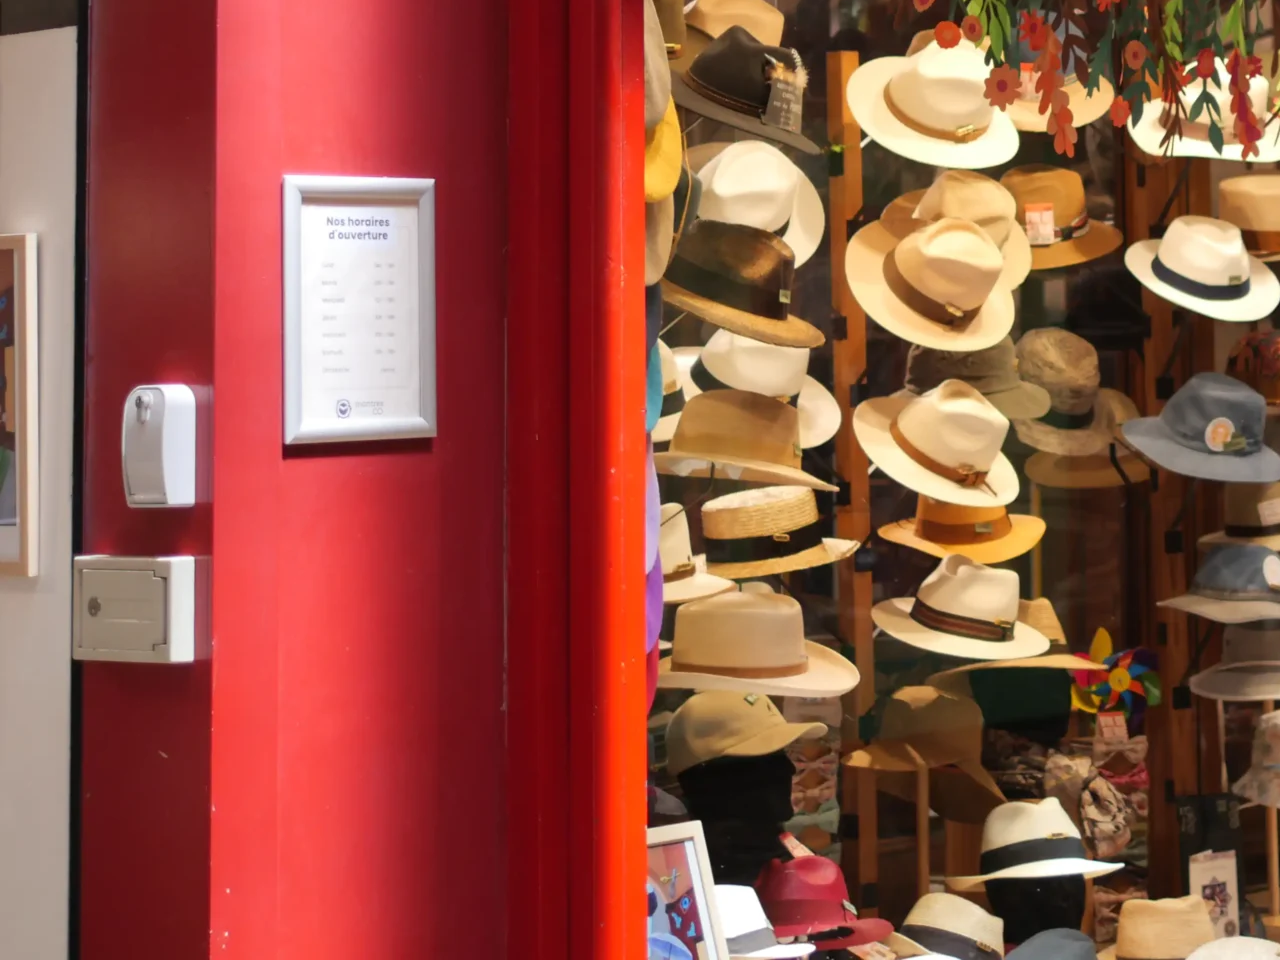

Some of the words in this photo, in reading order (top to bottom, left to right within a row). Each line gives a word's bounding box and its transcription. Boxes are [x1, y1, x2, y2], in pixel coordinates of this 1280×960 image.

[326, 216, 346, 227] Nos
[347, 215, 391, 227] horaires
[328, 229, 389, 240] d'ouverture
